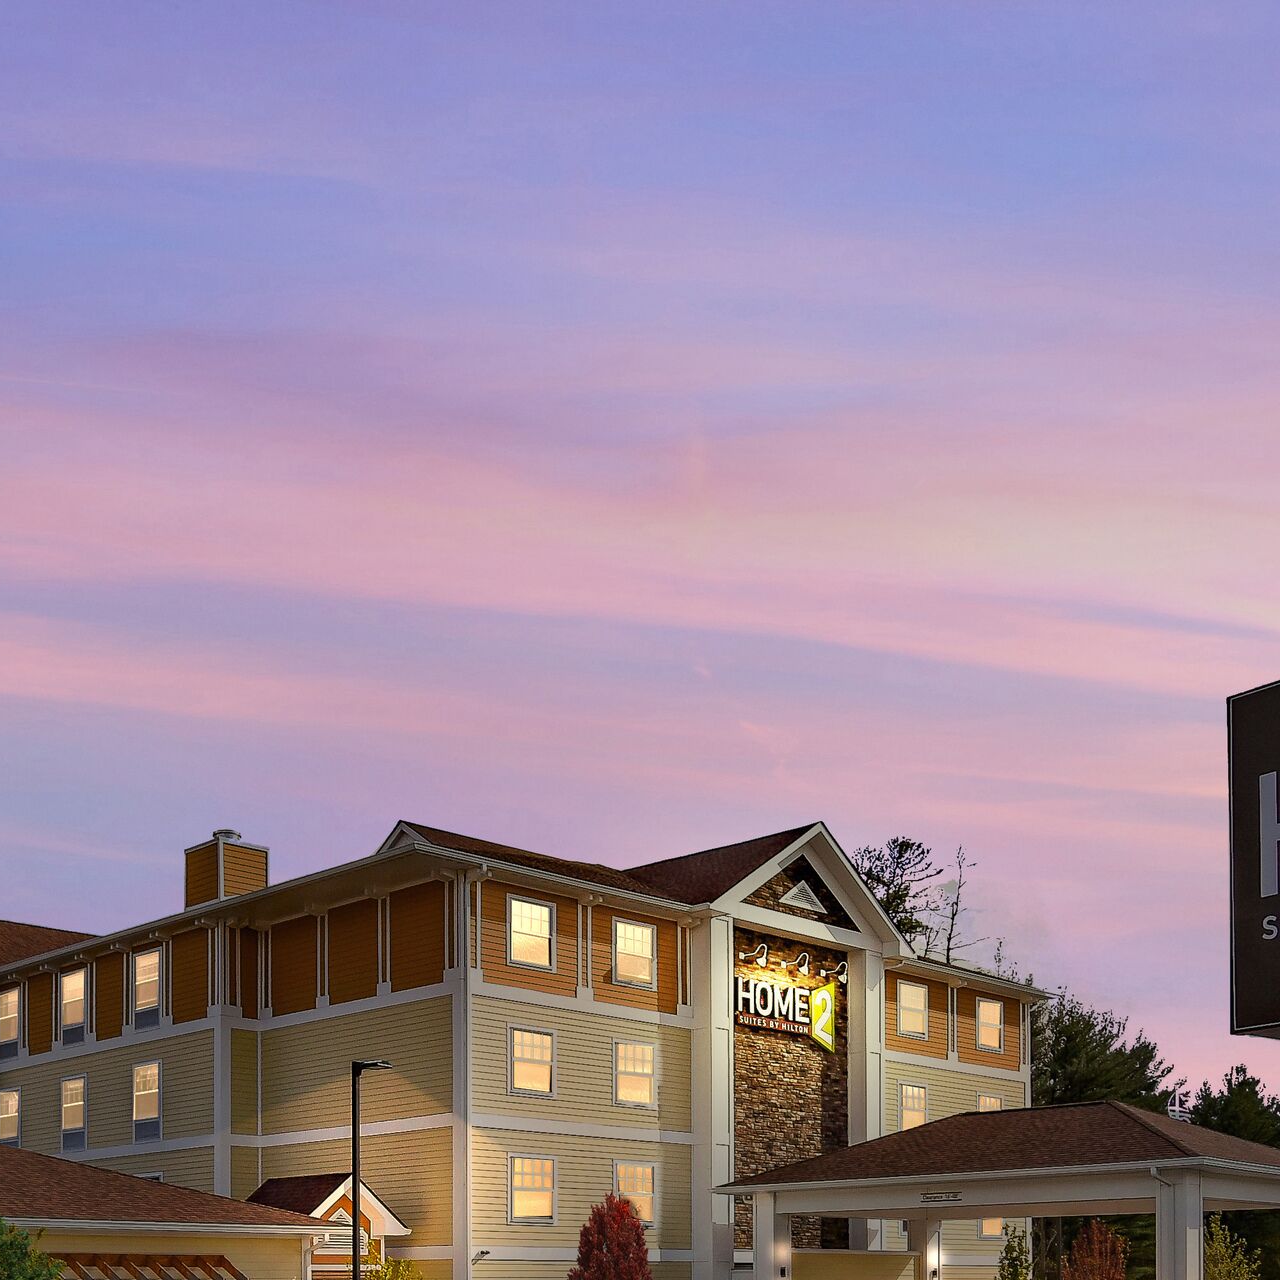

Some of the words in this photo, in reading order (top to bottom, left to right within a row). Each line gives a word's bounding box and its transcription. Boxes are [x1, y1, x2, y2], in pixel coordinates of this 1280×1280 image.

[738, 977, 810, 1023] HOME
[814, 989, 833, 1046] 2
[739, 1015, 767, 1027] SUITES
[769, 1020, 780, 1029] BY
[782, 1022, 809, 1034] HILTON
